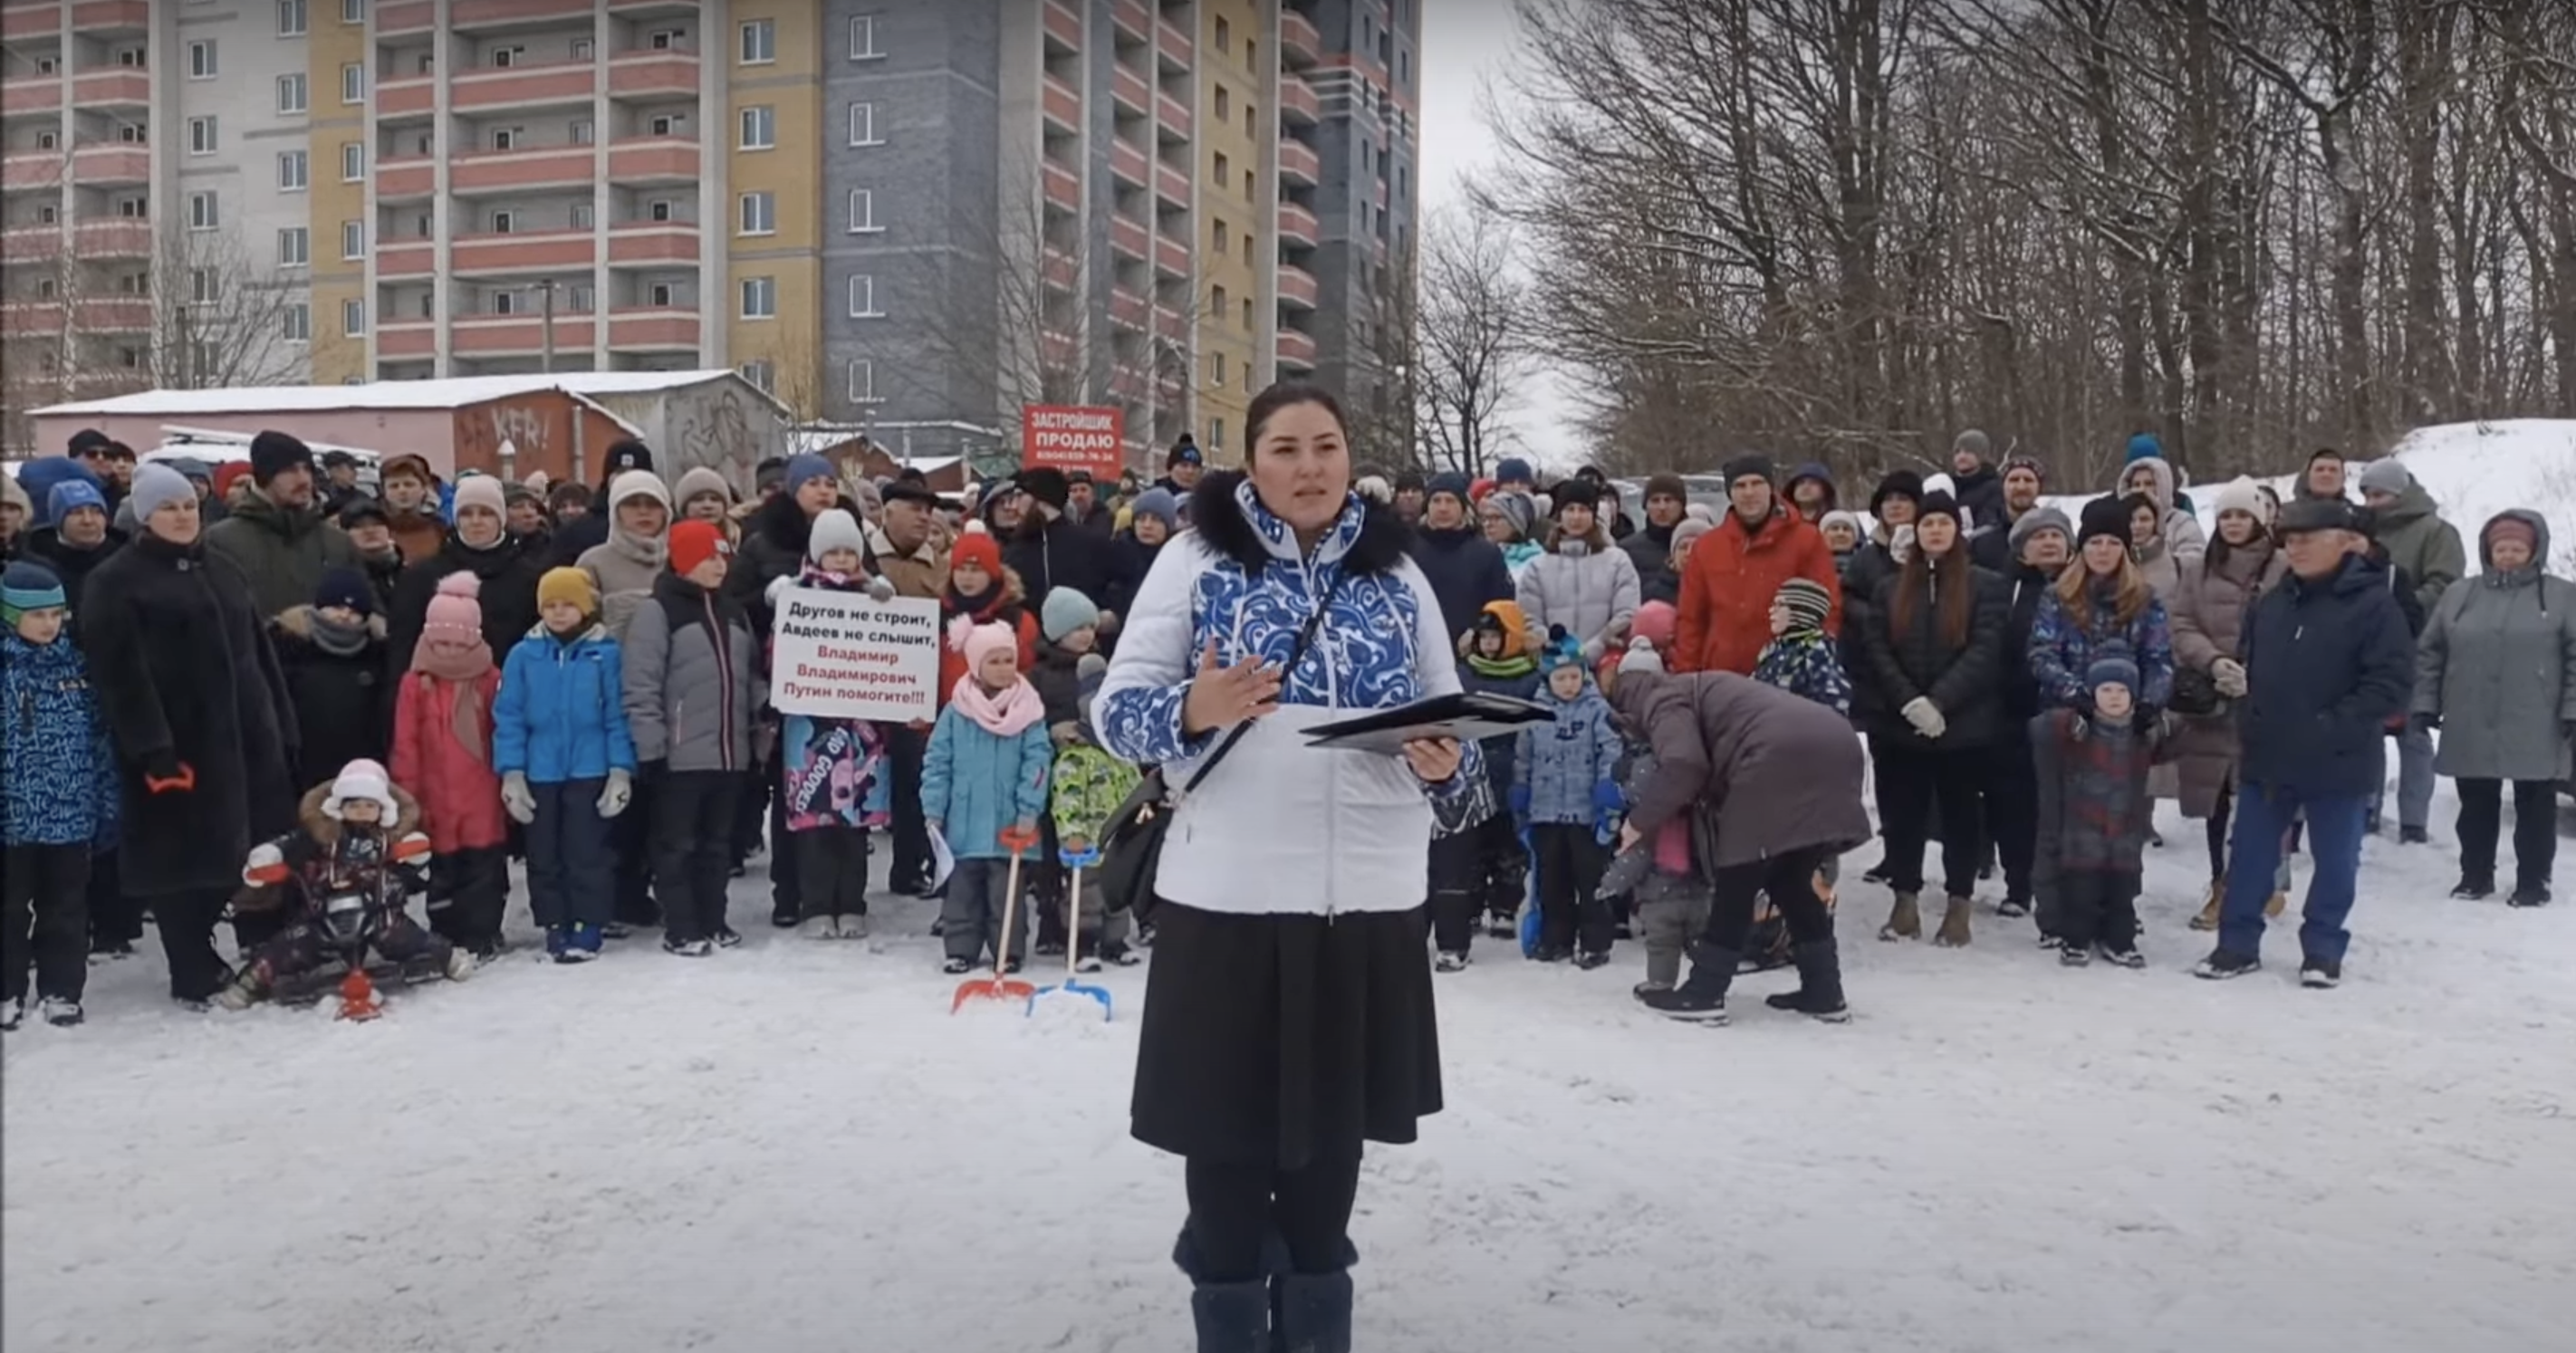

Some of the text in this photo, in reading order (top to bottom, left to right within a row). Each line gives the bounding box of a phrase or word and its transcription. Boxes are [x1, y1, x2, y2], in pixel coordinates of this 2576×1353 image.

[1035, 432, 1115, 450] ПРОДАЮ
[789, 601, 931, 629] Другов не строит,
[782, 622, 936, 648] Авдеев не слышит,
[818, 645, 899, 666] Владимир
[797, 664, 917, 685] Владимирович
[783, 682, 925, 705] Путин помогите!!!
